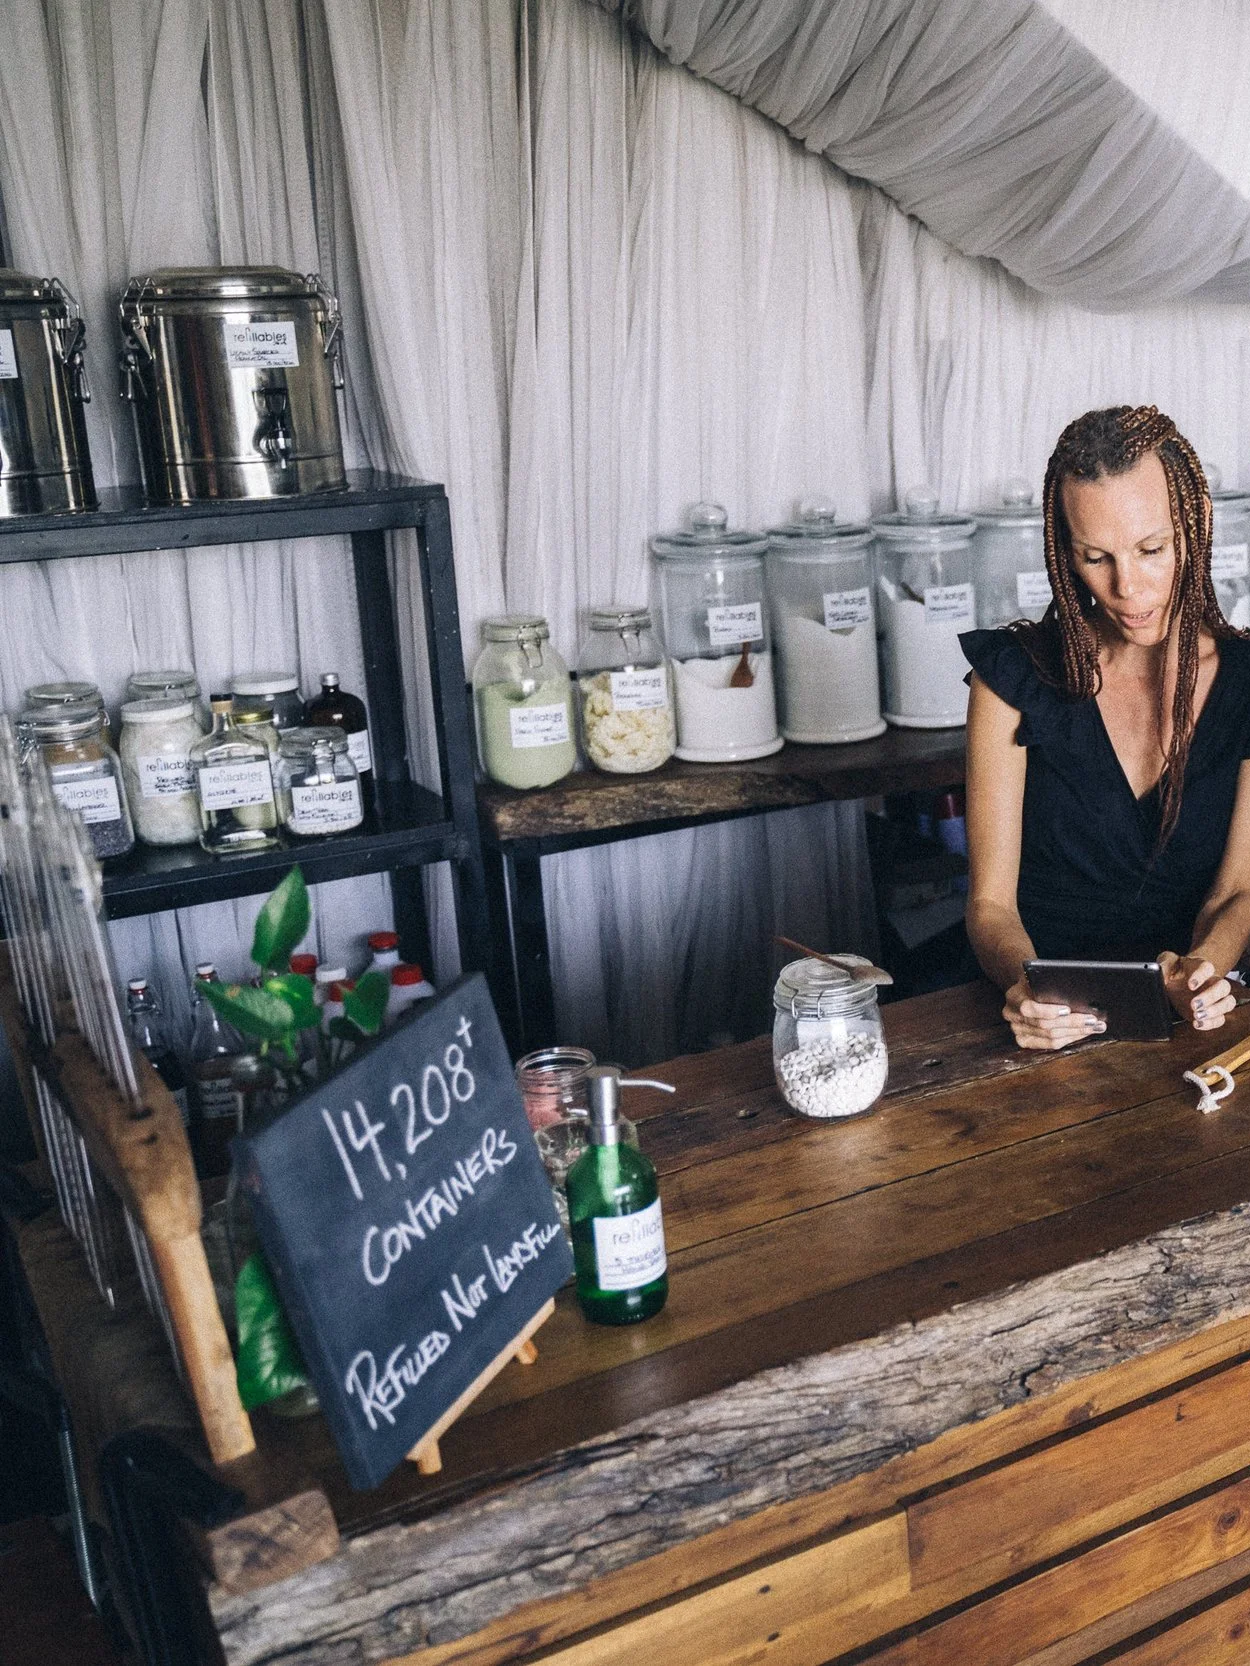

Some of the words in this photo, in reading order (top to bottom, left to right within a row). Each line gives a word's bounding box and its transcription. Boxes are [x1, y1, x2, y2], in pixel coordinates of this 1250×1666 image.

[233, 327, 287, 342] refillables
[146, 758, 191, 773] refillabl
[55, 786, 109, 801] efillables
[362, 1128, 518, 1286] CONTAINERS
[345, 1330, 451, 1431] REFILLED
[441, 1273, 488, 1333] NOT
